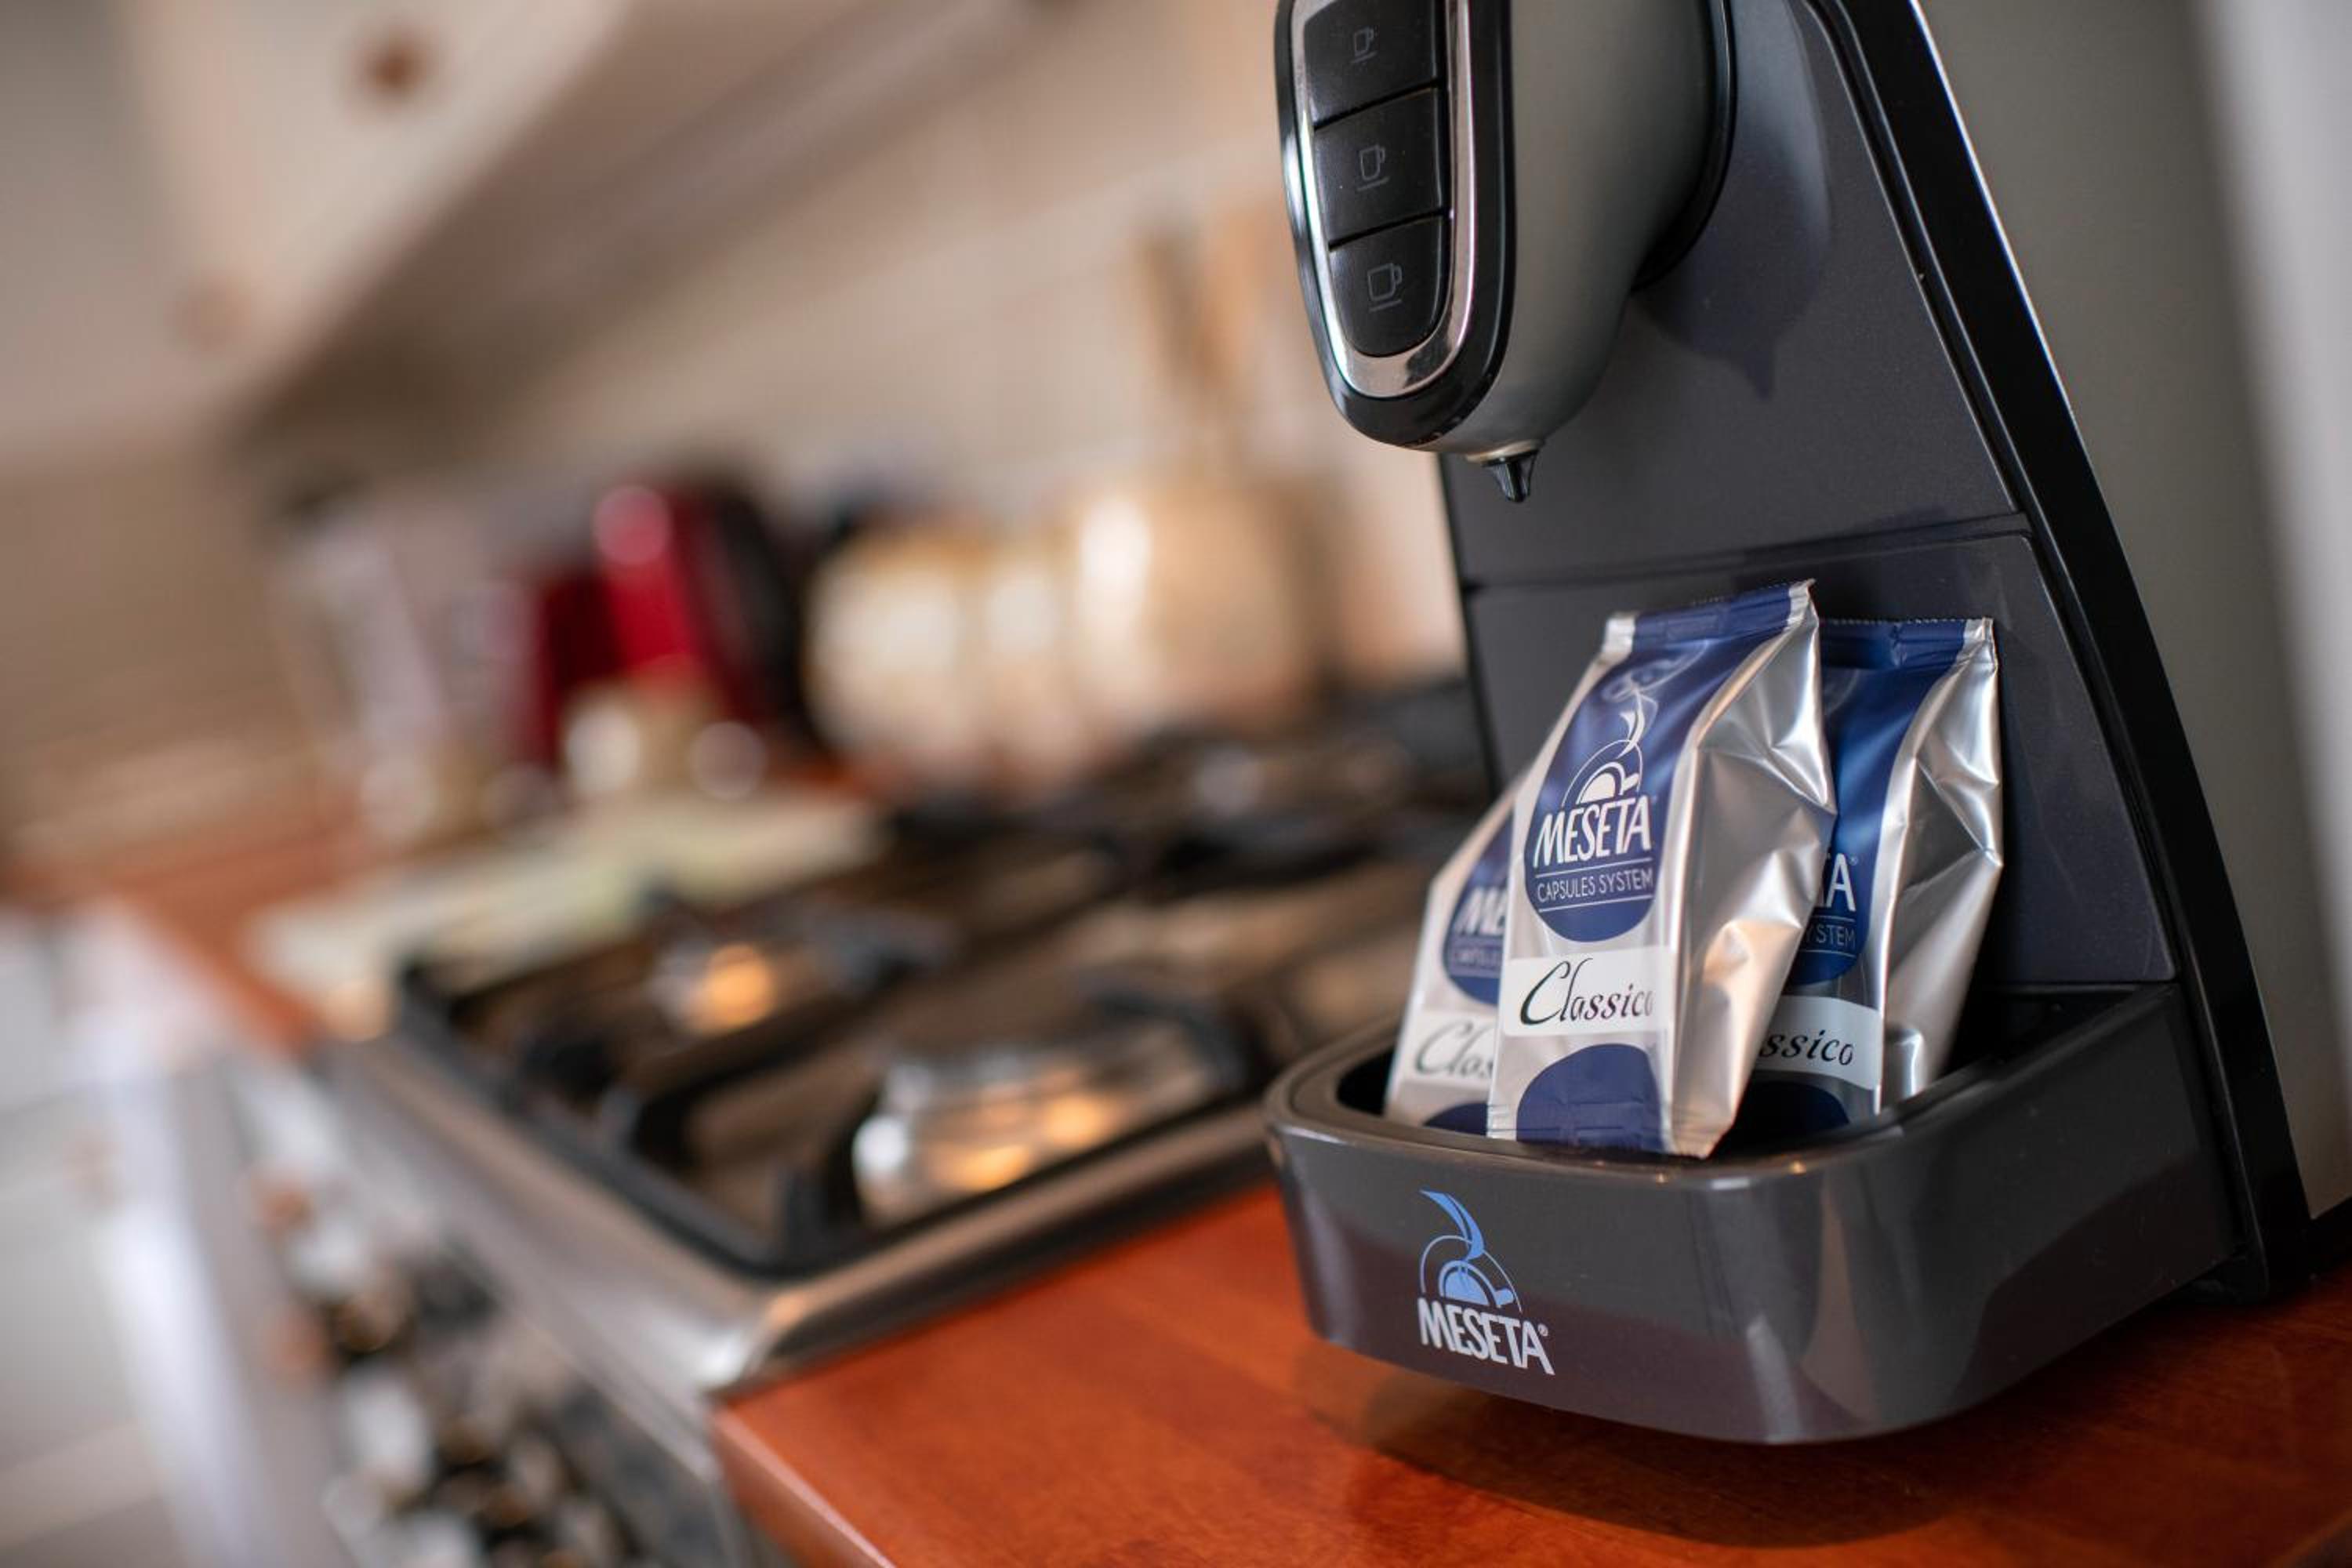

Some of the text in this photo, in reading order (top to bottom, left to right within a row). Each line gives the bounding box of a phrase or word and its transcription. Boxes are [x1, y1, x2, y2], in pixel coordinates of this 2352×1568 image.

[1534, 795, 1652, 869] MESETA
[1537, 867, 1653, 902] CAPSULES SYSTEM
[1521, 958, 1653, 1025] Classico
[1759, 1029, 1853, 1065] ssico
